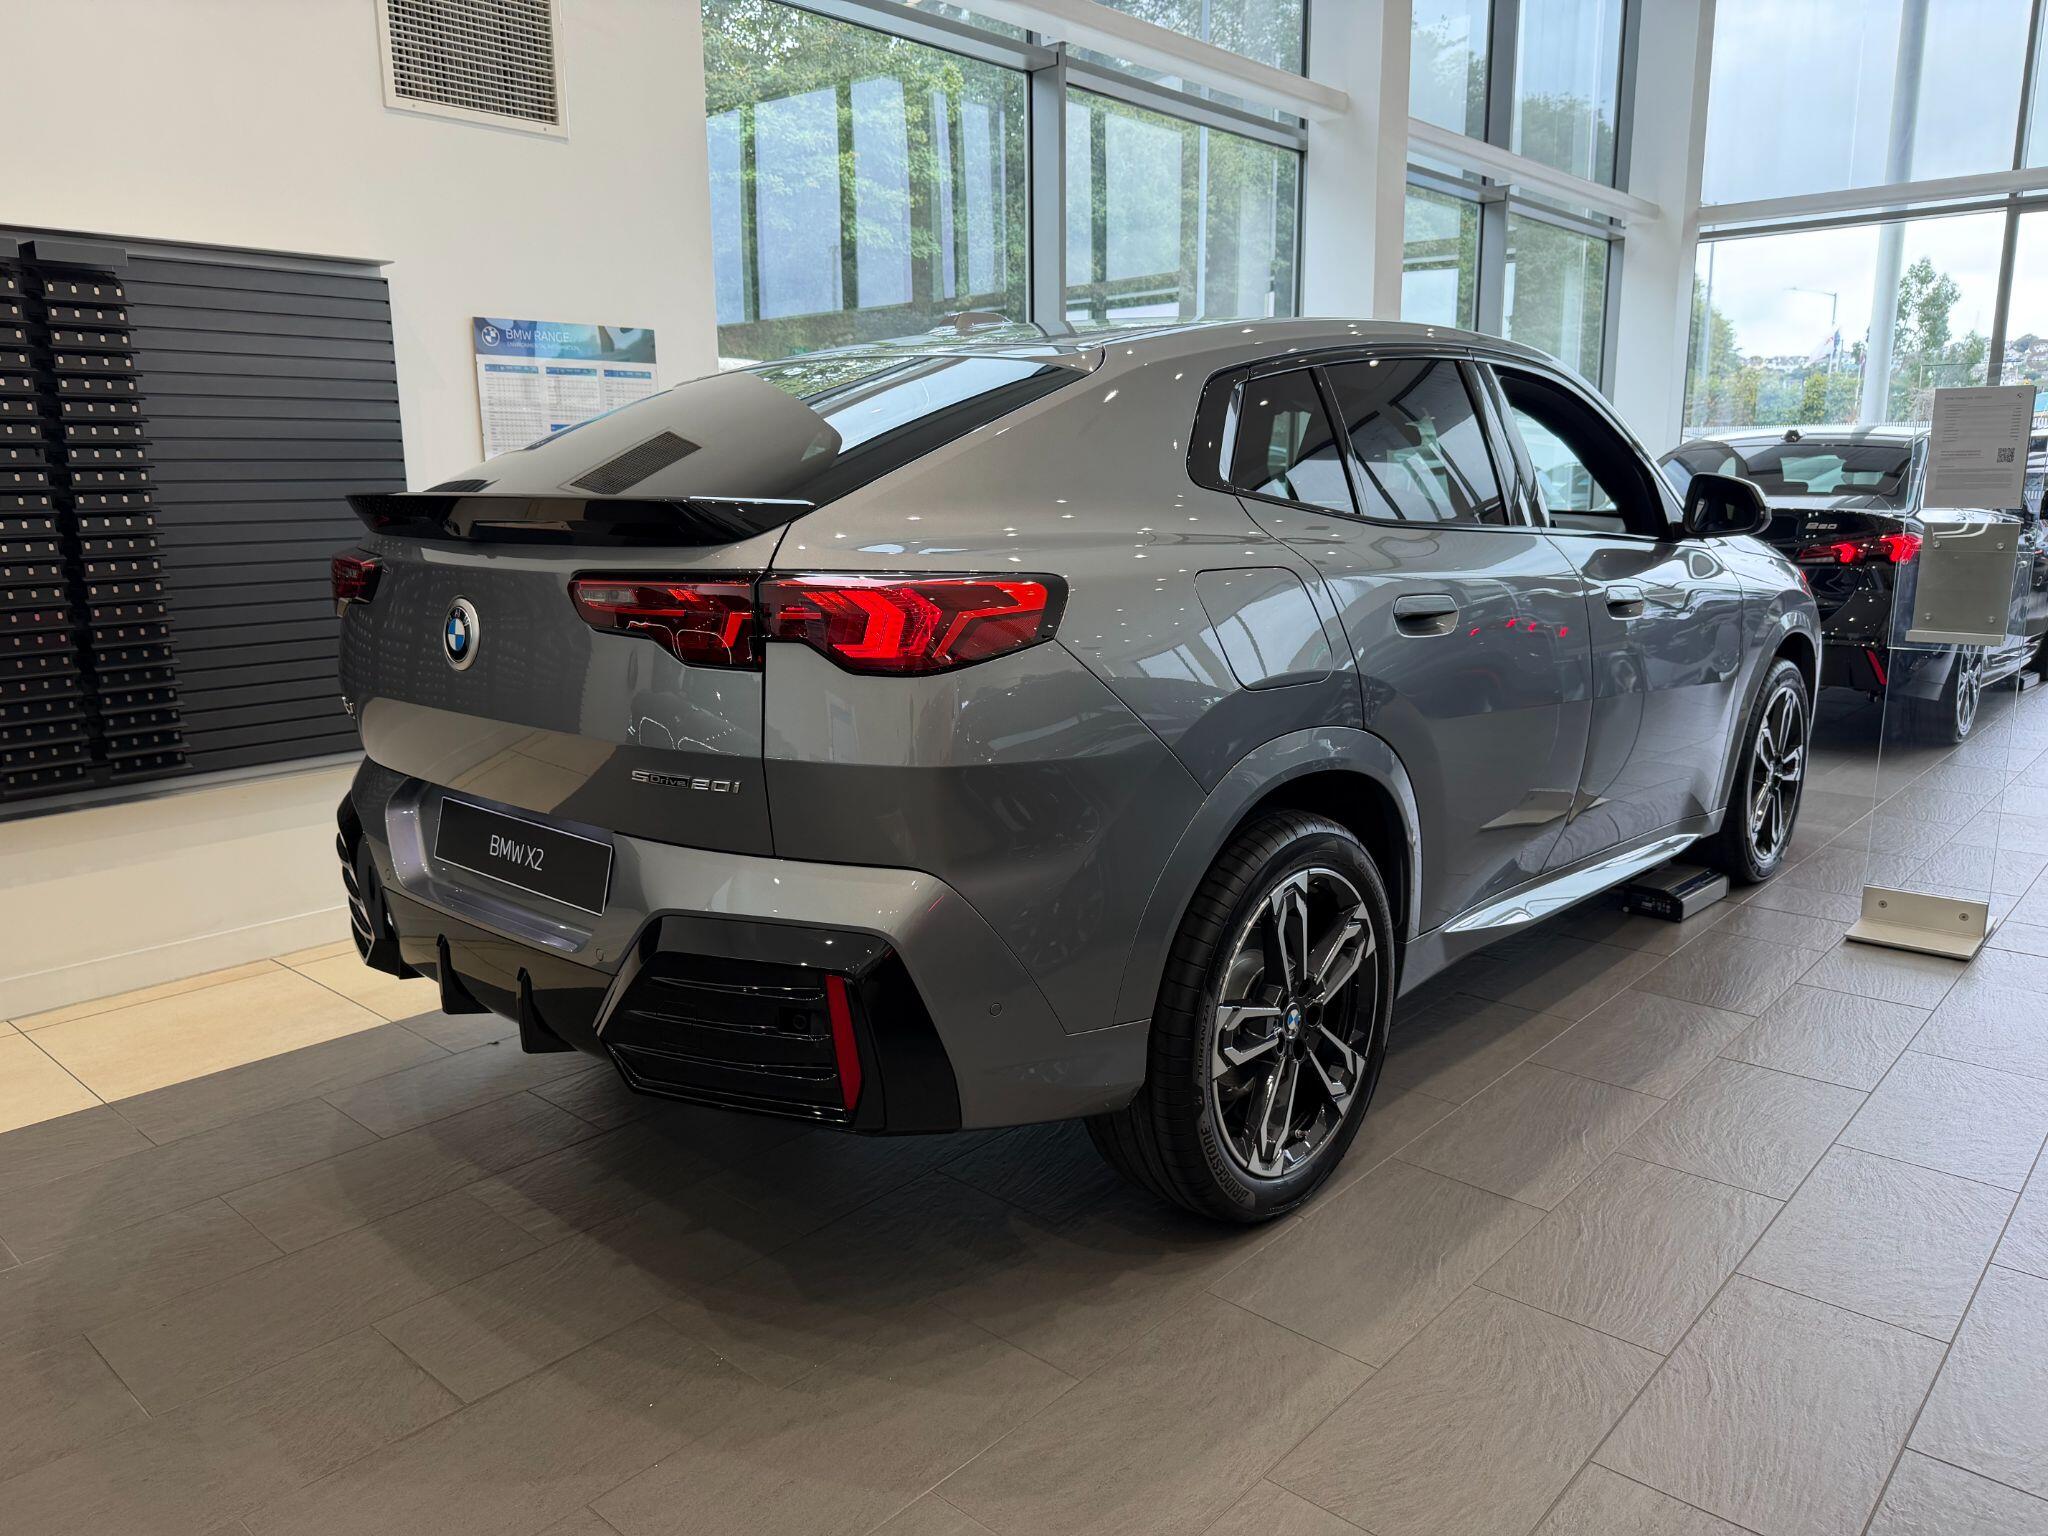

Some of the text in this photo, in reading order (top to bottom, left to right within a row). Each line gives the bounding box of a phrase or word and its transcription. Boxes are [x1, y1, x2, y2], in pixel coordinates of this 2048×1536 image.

[505, 329, 570, 343] BMW RANGE
[489, 834, 544, 871] BMW X2
[1201, 1126, 1250, 1205] BRIDGESTONE
